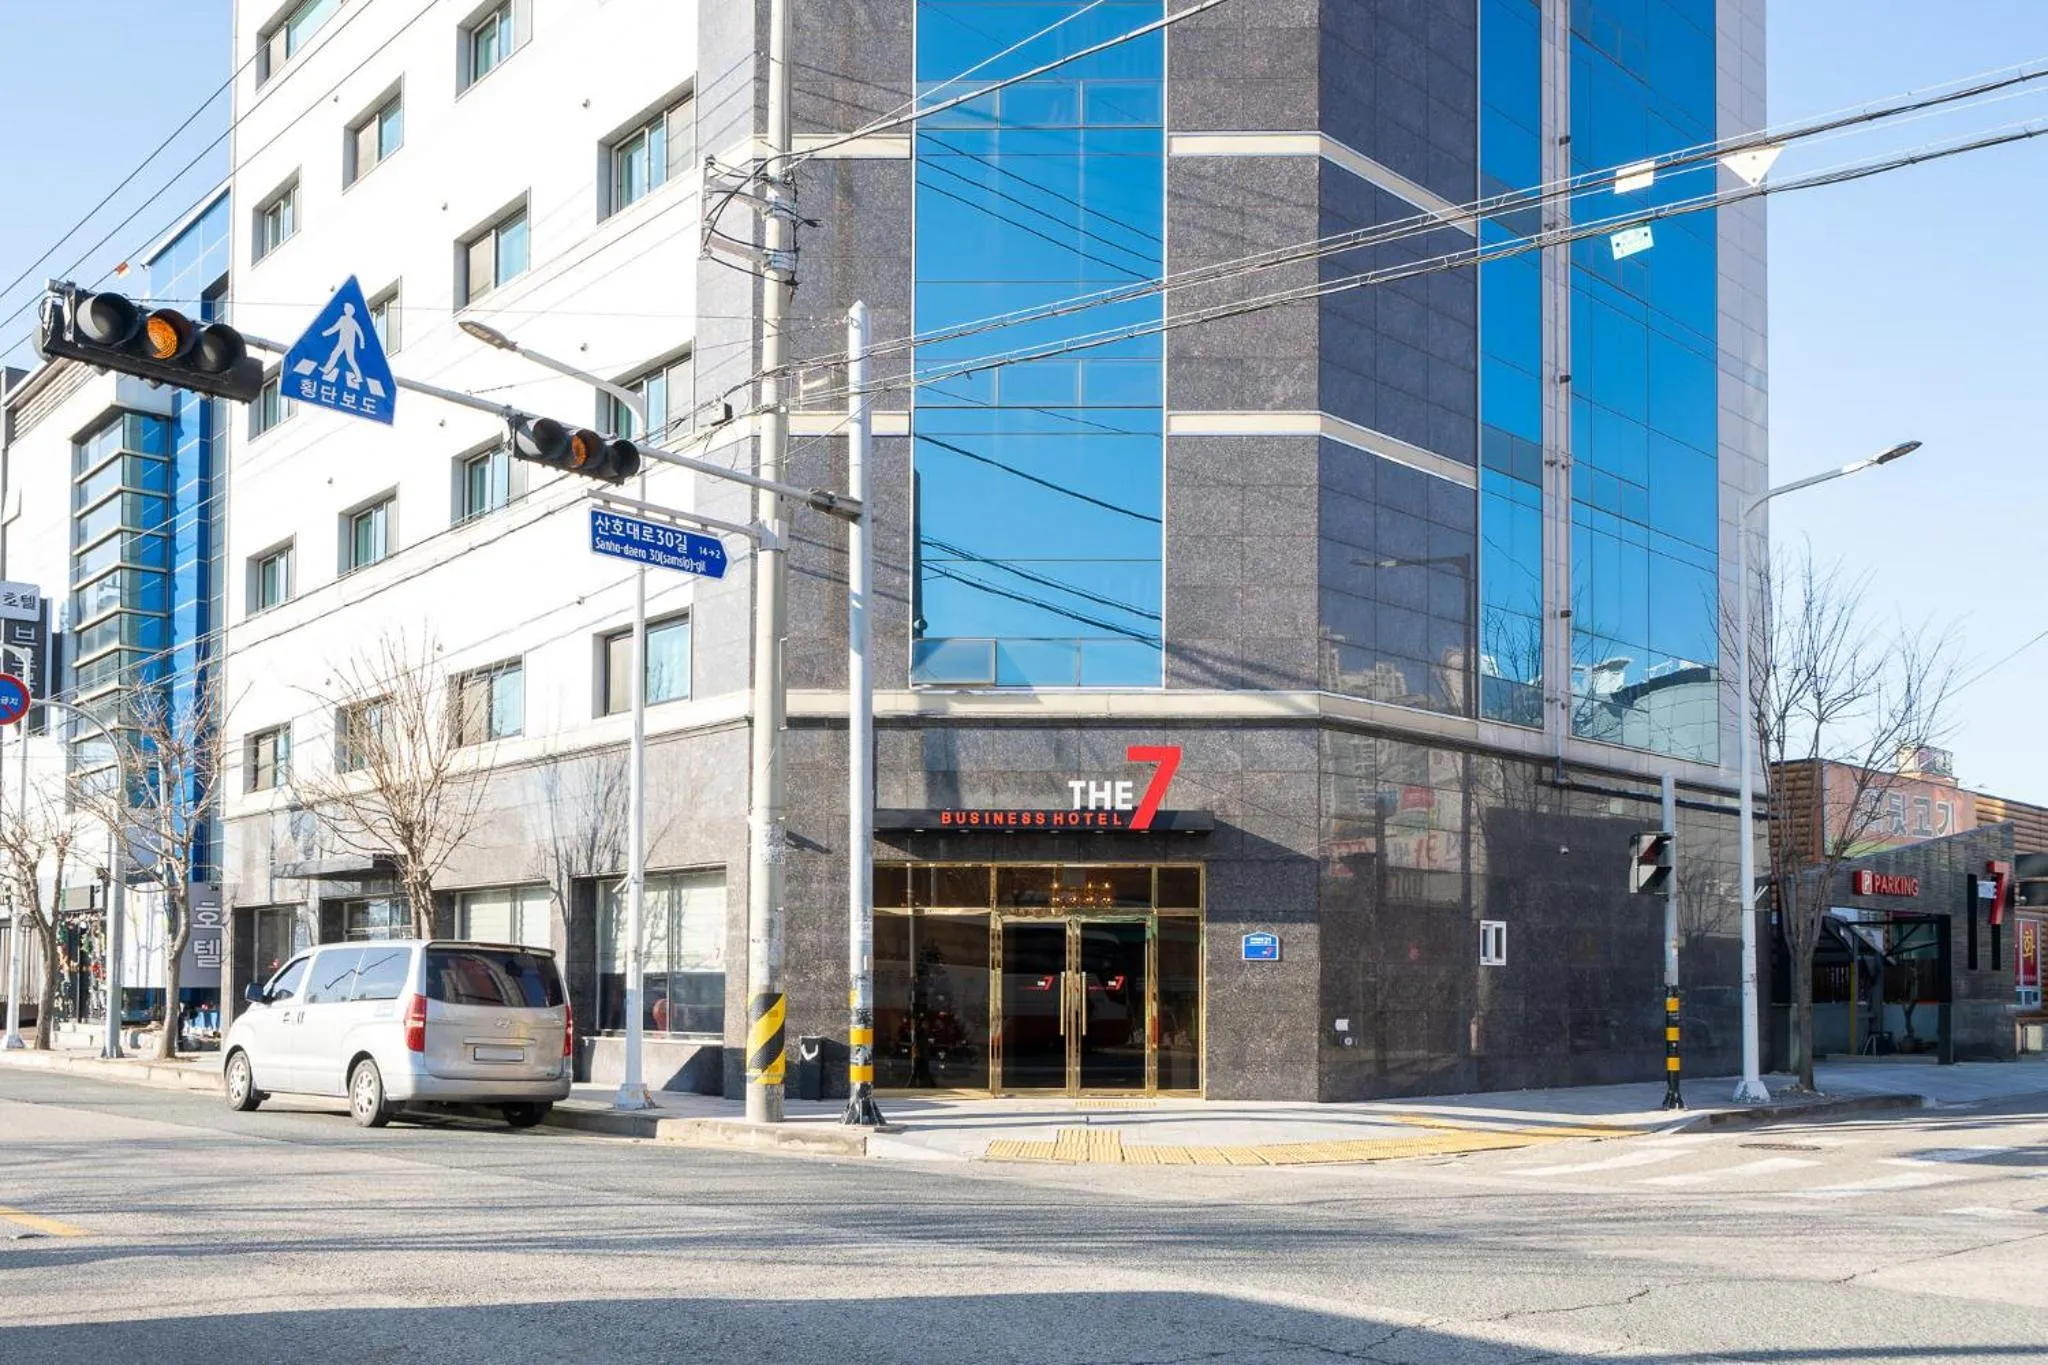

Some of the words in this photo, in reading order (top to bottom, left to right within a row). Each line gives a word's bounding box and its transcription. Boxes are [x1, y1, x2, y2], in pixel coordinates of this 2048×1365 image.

[299, 377, 377, 415] 횡단보도
[595, 514, 688, 554] 산호대로30길
[595, 536, 647, 559] Sanho-daero
[649, 548, 706, 573] 30(samsip)-gil
[1068, 780, 1133, 810] THE
[1126, 745, 1183, 830] 7
[941, 811, 1046, 825] BUSINESS
[1053, 812, 1122, 825] HOTEL
[1875, 873, 1920, 897] PARKING
[192, 901, 222, 968] 호텔
